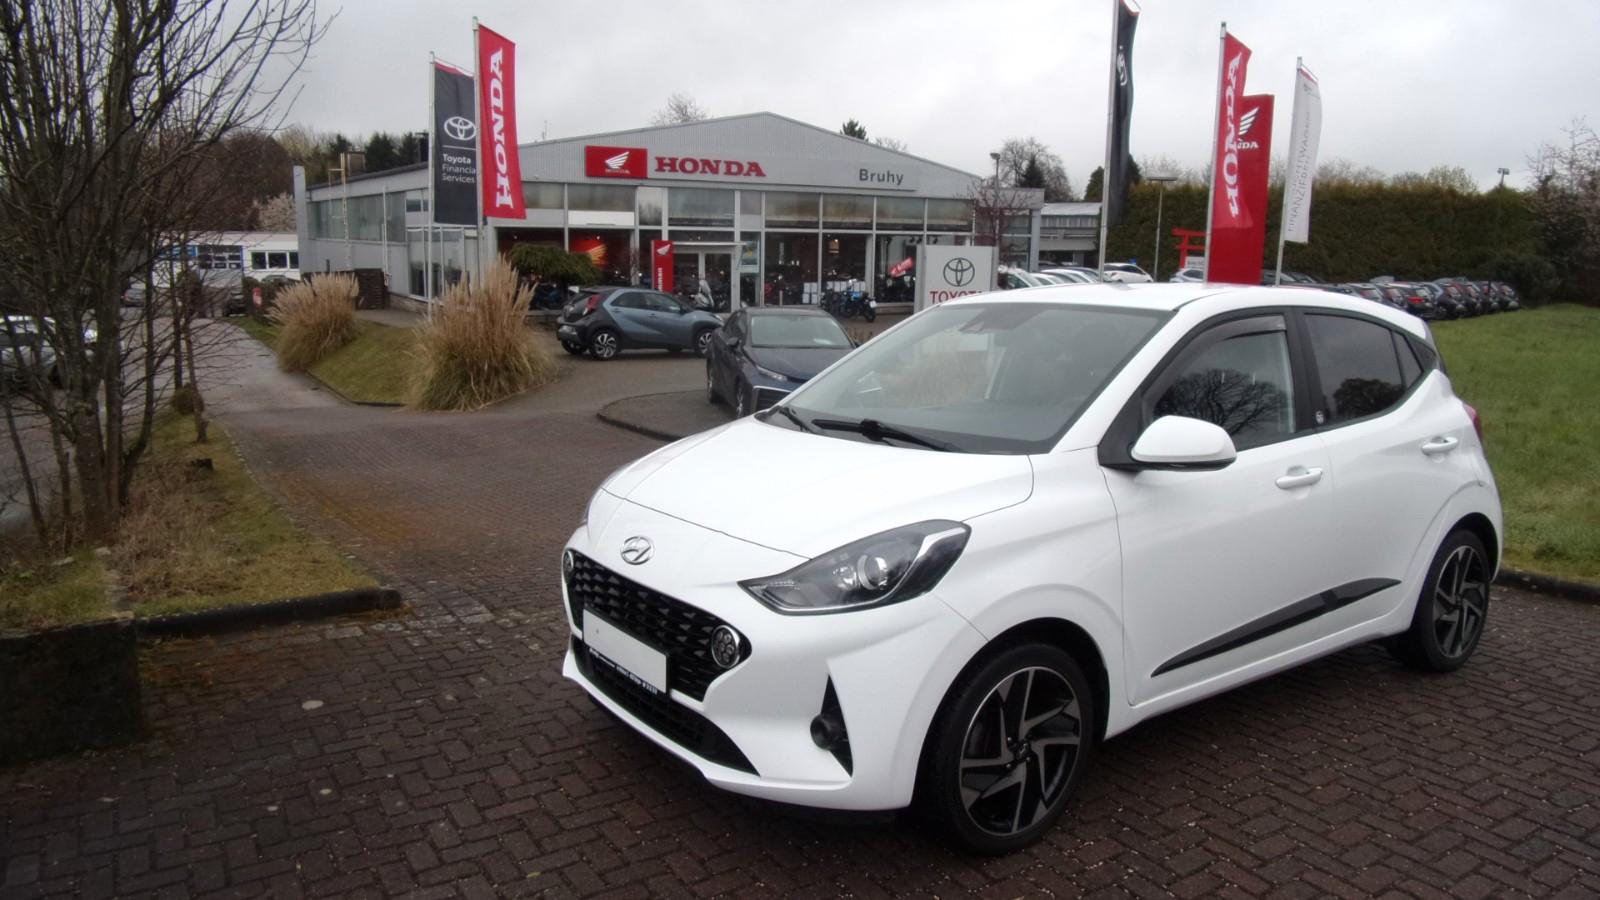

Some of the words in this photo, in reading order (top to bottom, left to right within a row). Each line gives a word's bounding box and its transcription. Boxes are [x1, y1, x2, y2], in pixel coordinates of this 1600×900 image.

[490, 48, 513, 209] HONDA
[1222, 51, 1242, 218] HONDA
[442, 153, 472, 165] Toyota
[655, 156, 766, 177] HONDA
[442, 163, 476, 175] Financia
[859, 168, 904, 186] Bruhy
[930, 290, 982, 304] TOY
